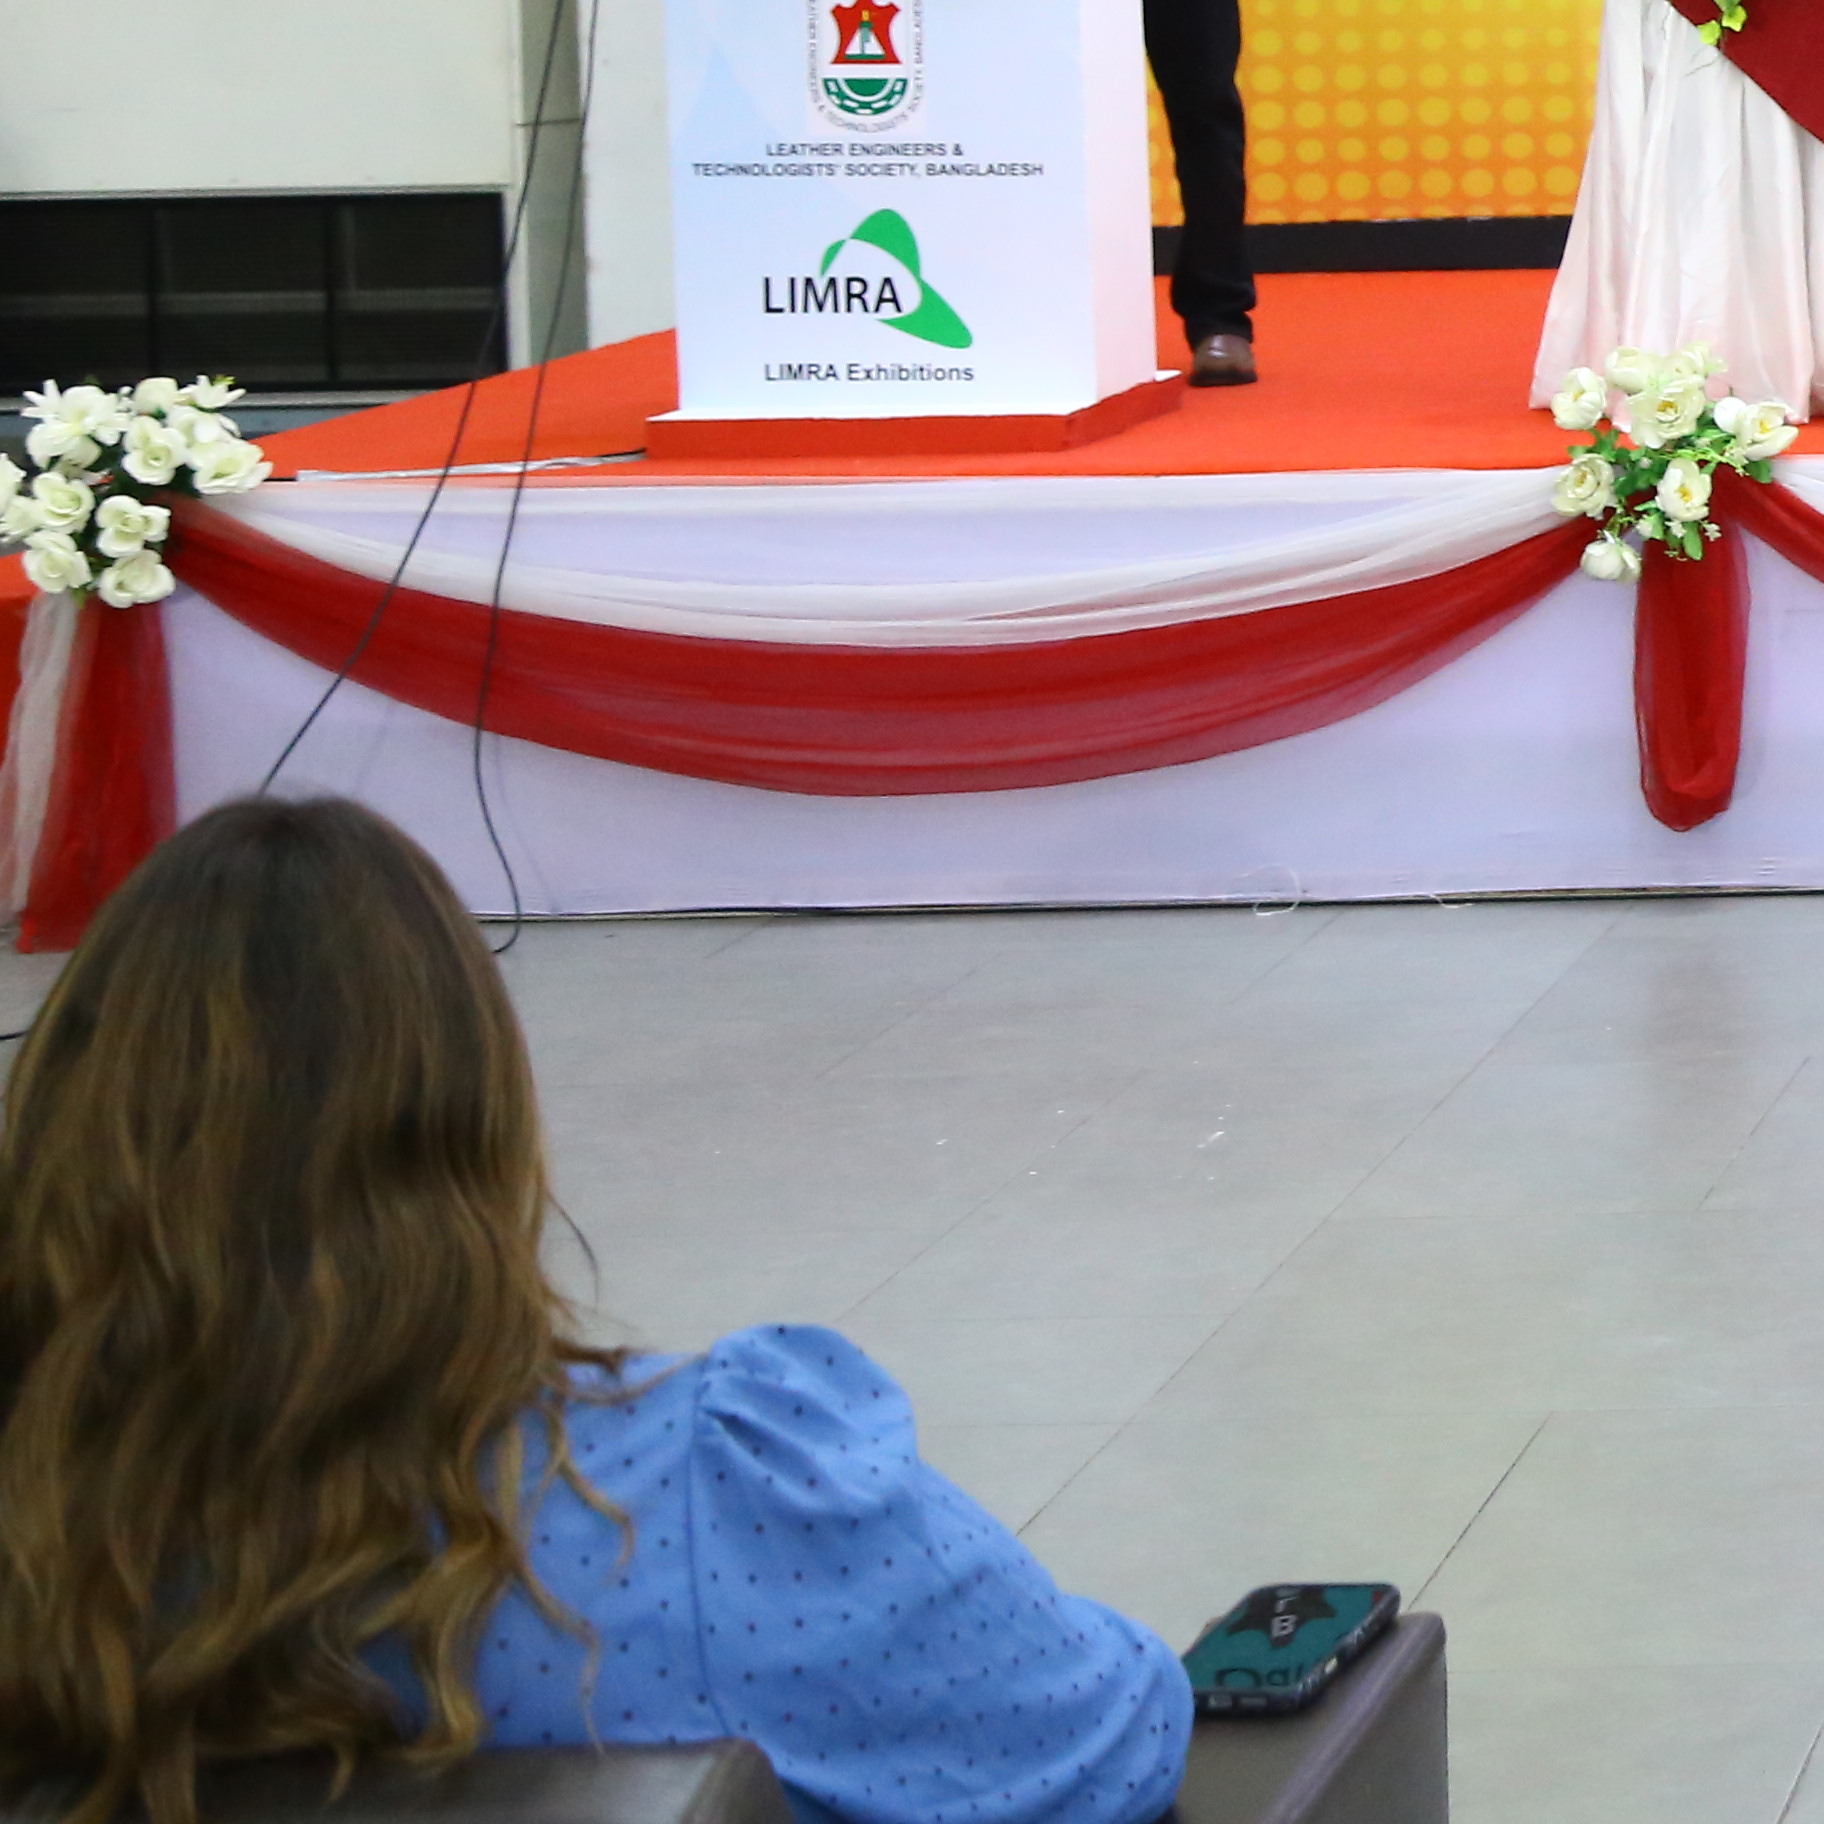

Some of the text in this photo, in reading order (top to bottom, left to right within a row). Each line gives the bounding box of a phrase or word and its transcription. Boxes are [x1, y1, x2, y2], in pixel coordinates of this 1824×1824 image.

[765, 142, 844, 157] LEATHER
[849, 142, 948, 157] ENGINEERS
[925, 162, 1044, 177] BANGLADESH
[764, 276, 904, 313] LIMRA
[764, 362, 975, 382] LIMRA Exhibitions
